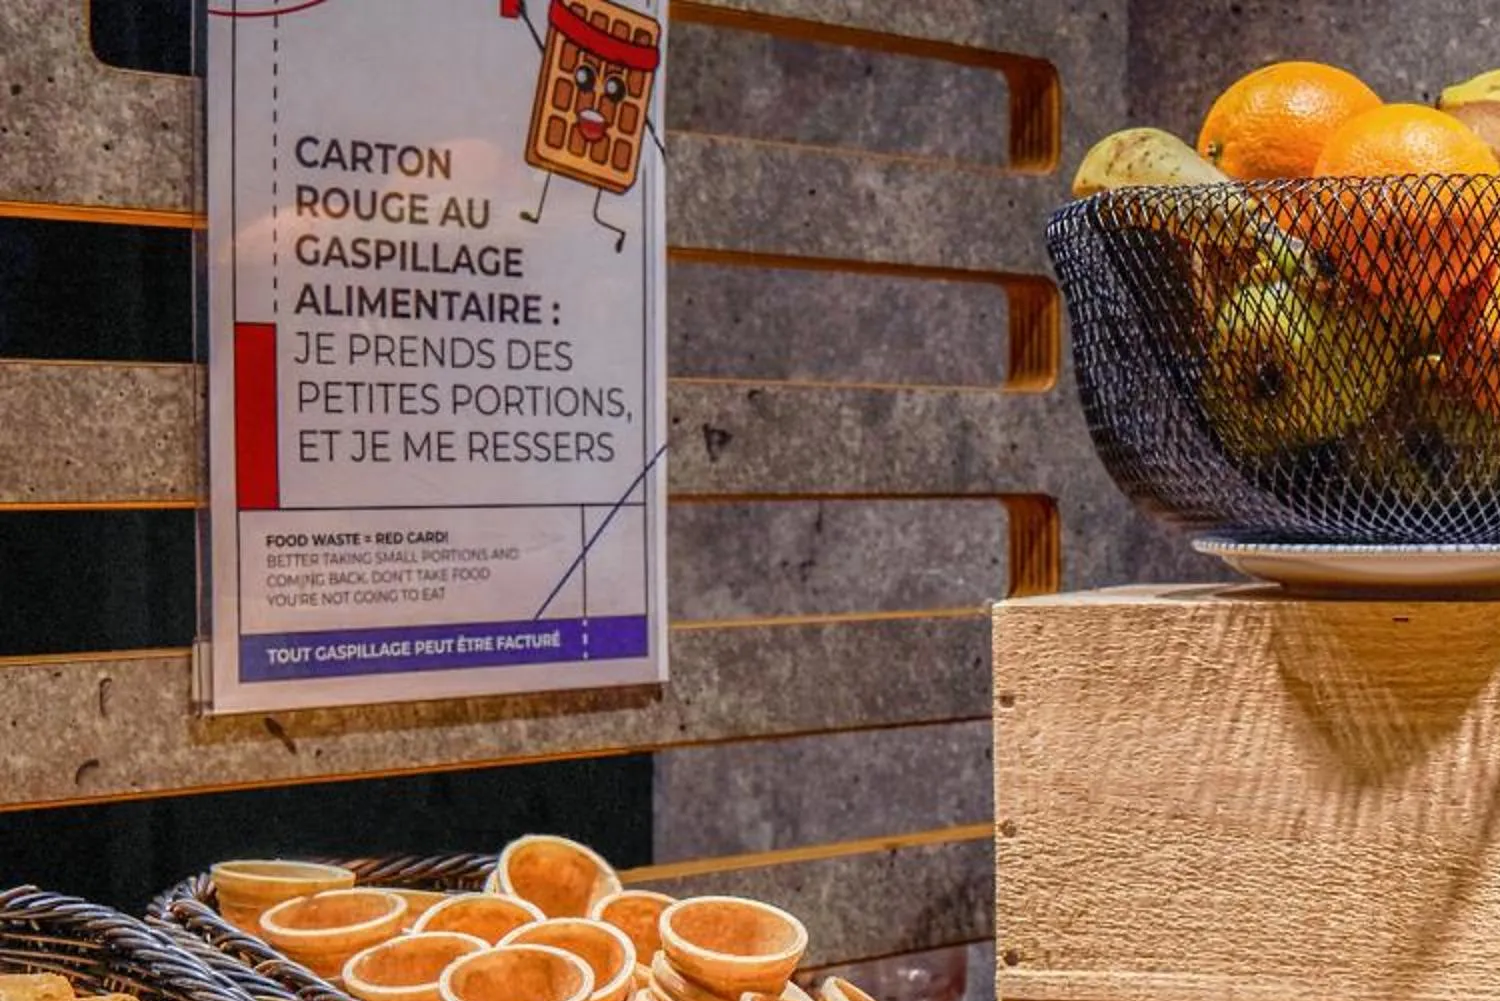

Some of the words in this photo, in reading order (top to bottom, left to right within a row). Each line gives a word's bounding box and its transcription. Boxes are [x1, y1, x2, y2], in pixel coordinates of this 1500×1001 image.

[295, 136, 452, 179] CARTON
[296, 184, 429, 225] ROUGE
[439, 197, 490, 229] AU
[295, 234, 523, 278] GASPILLAGE
[294, 283, 542, 325] ALIMENTAIRE
[294, 332, 336, 365] JE
[349, 333, 496, 369] PRENDS
[507, 339, 573, 371] DES
[299, 381, 440, 415] PETITES
[452, 384, 632, 423] PORTIONS,
[300, 430, 341, 462] ET
[351, 430, 391, 462] JE
[404, 432, 455, 462] ME
[469, 432, 615, 463] RESSERS
[266, 534, 308, 547] FOOD
[312, 533, 361, 545] WASTE
[375, 532, 403, 544] RED
[407, 531, 449, 544] CARD!
[267, 553, 319, 568] BETTER
[323, 551, 372, 565] TAKING
[375, 550, 417, 563] SMALL
[422, 548, 488, 562] PORTIONS
[490, 548, 519, 560] AND
[416, 568, 448, 581] TAKE
[451, 567, 490, 580] FOOD
[321, 591, 349, 605] NOT
[354, 589, 398, 604] GOING
[402, 588, 418, 601] TO
[423, 587, 445, 600] EAT
[267, 647, 311, 663] TOUT
[315, 641, 411, 661] GASPILLAGE
[415, 638, 454, 655] PEUT
[457, 634, 493, 650] ÊTRE
[497, 630, 560, 648] FACTURÉ
